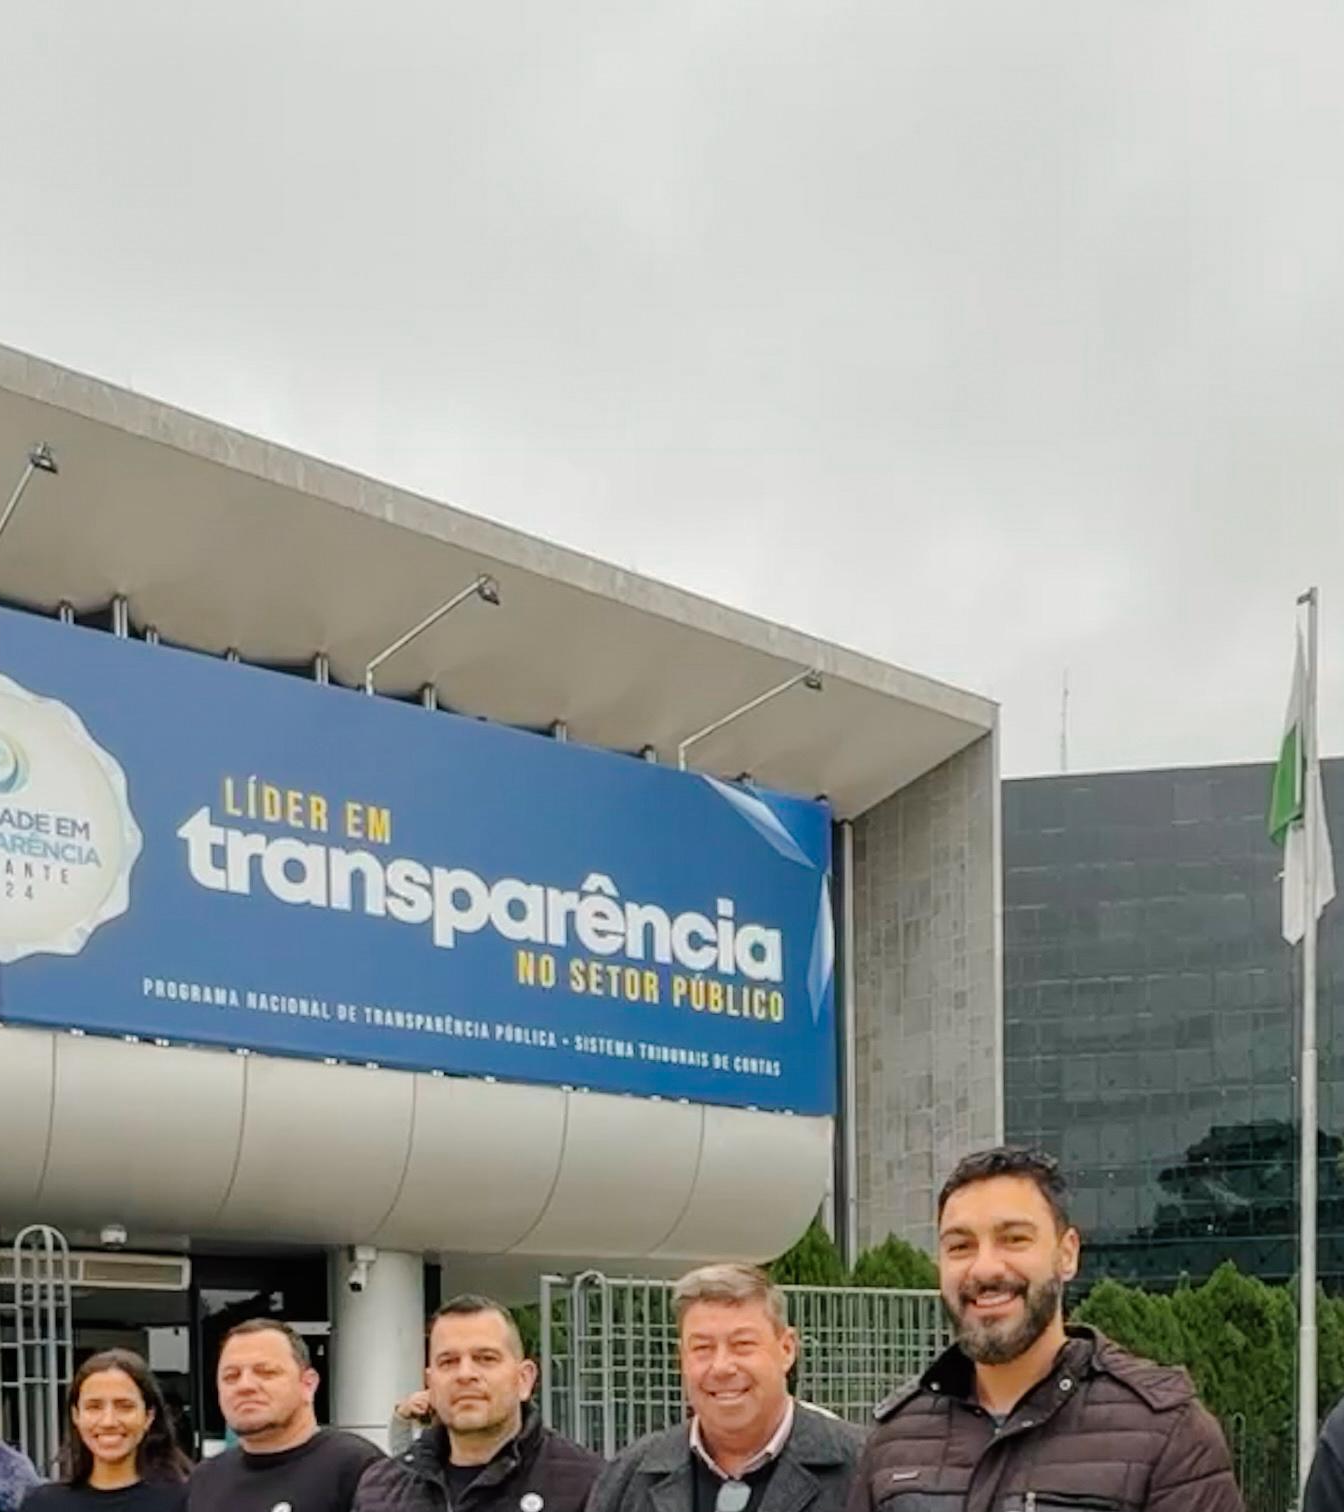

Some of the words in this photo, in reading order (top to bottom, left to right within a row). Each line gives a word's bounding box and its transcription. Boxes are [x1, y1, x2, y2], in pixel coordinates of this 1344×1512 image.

[55, 817, 91, 842] EM
[224, 773, 329, 834] LÍDER
[346, 800, 392, 845] EM
[176, 805, 784, 983] transparência
[516, 949, 556, 989] NO
[569, 957, 660, 1005] SETOR
[672, 973, 785, 1024] PÚBLICO
[142, 976, 241, 1008] PROGRAMA
[246, 990, 332, 1020] NACIONAL
[337, 1004, 357, 1023] DE
[365, 1006, 491, 1040] TRANSPARÊNCIA
[494, 1022, 557, 1048] PÚBLICA
[573, 1033, 635, 1059] SISTEMA
[638, 1041, 710, 1069] TRIBUNAIS
[712, 1052, 730, 1072] DE
[733, 1055, 782, 1078] CONTAS
